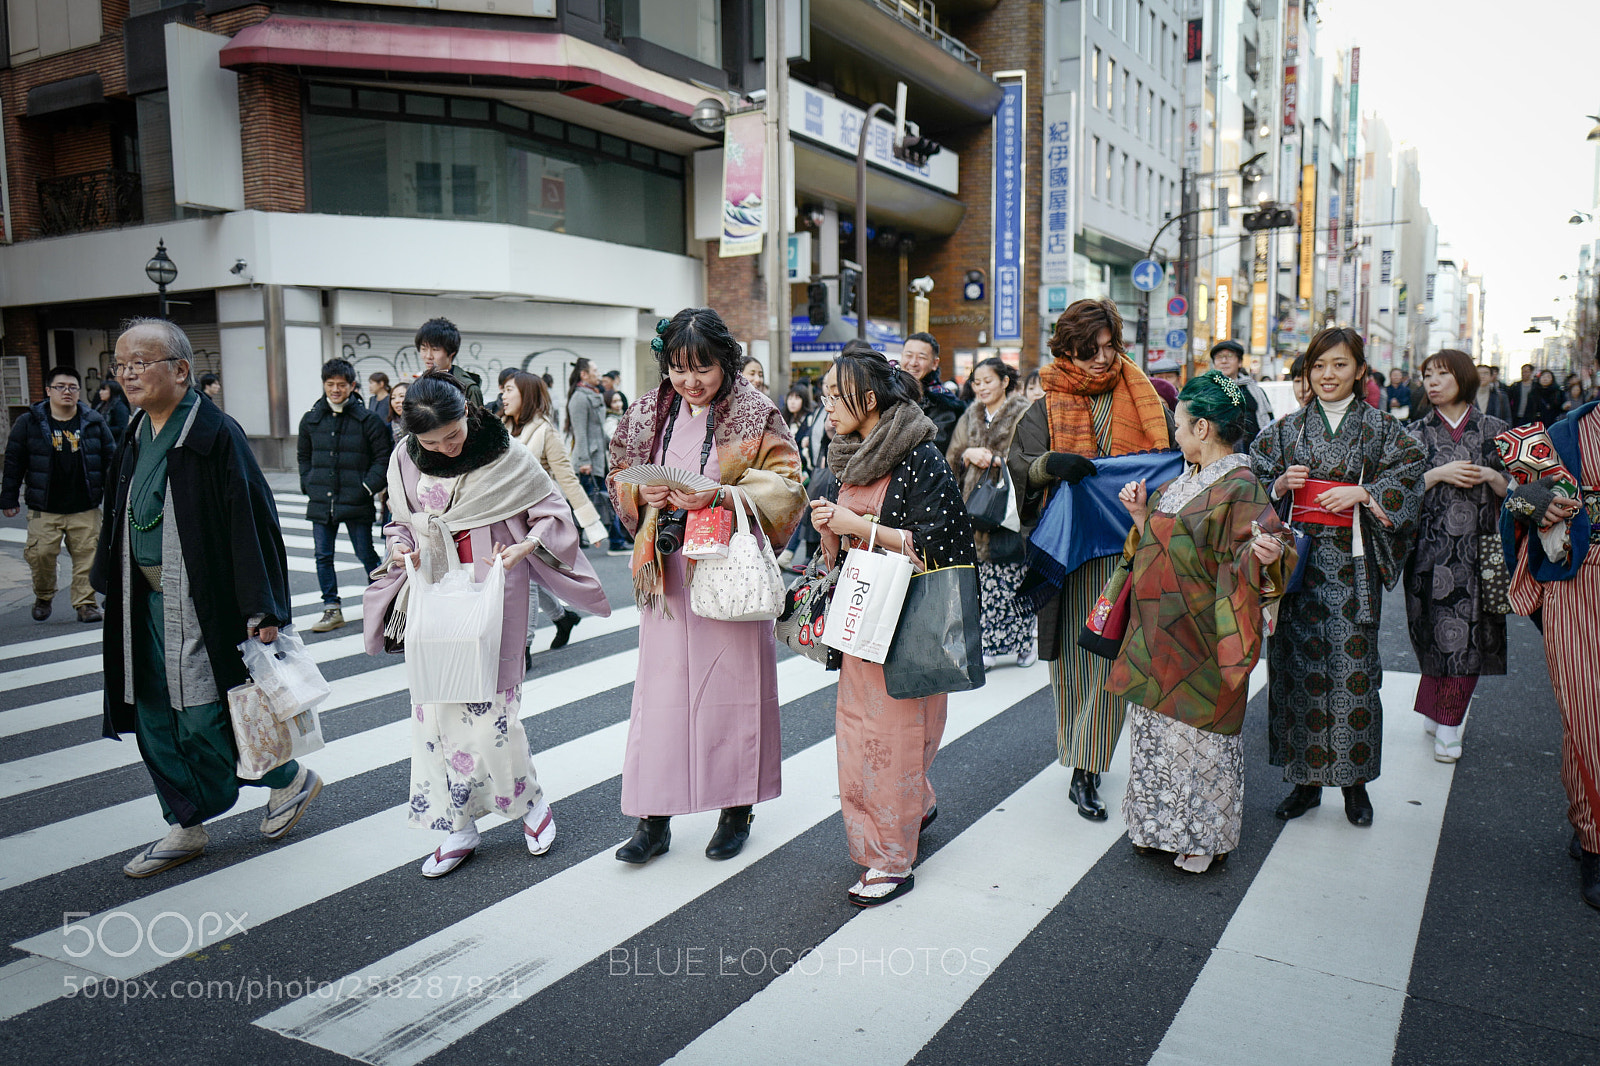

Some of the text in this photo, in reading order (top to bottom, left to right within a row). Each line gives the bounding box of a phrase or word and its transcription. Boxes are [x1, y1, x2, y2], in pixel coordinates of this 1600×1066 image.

[1048, 121, 1069, 254] 紀伊國屋書店
[842, 580, 870, 641] Relish
